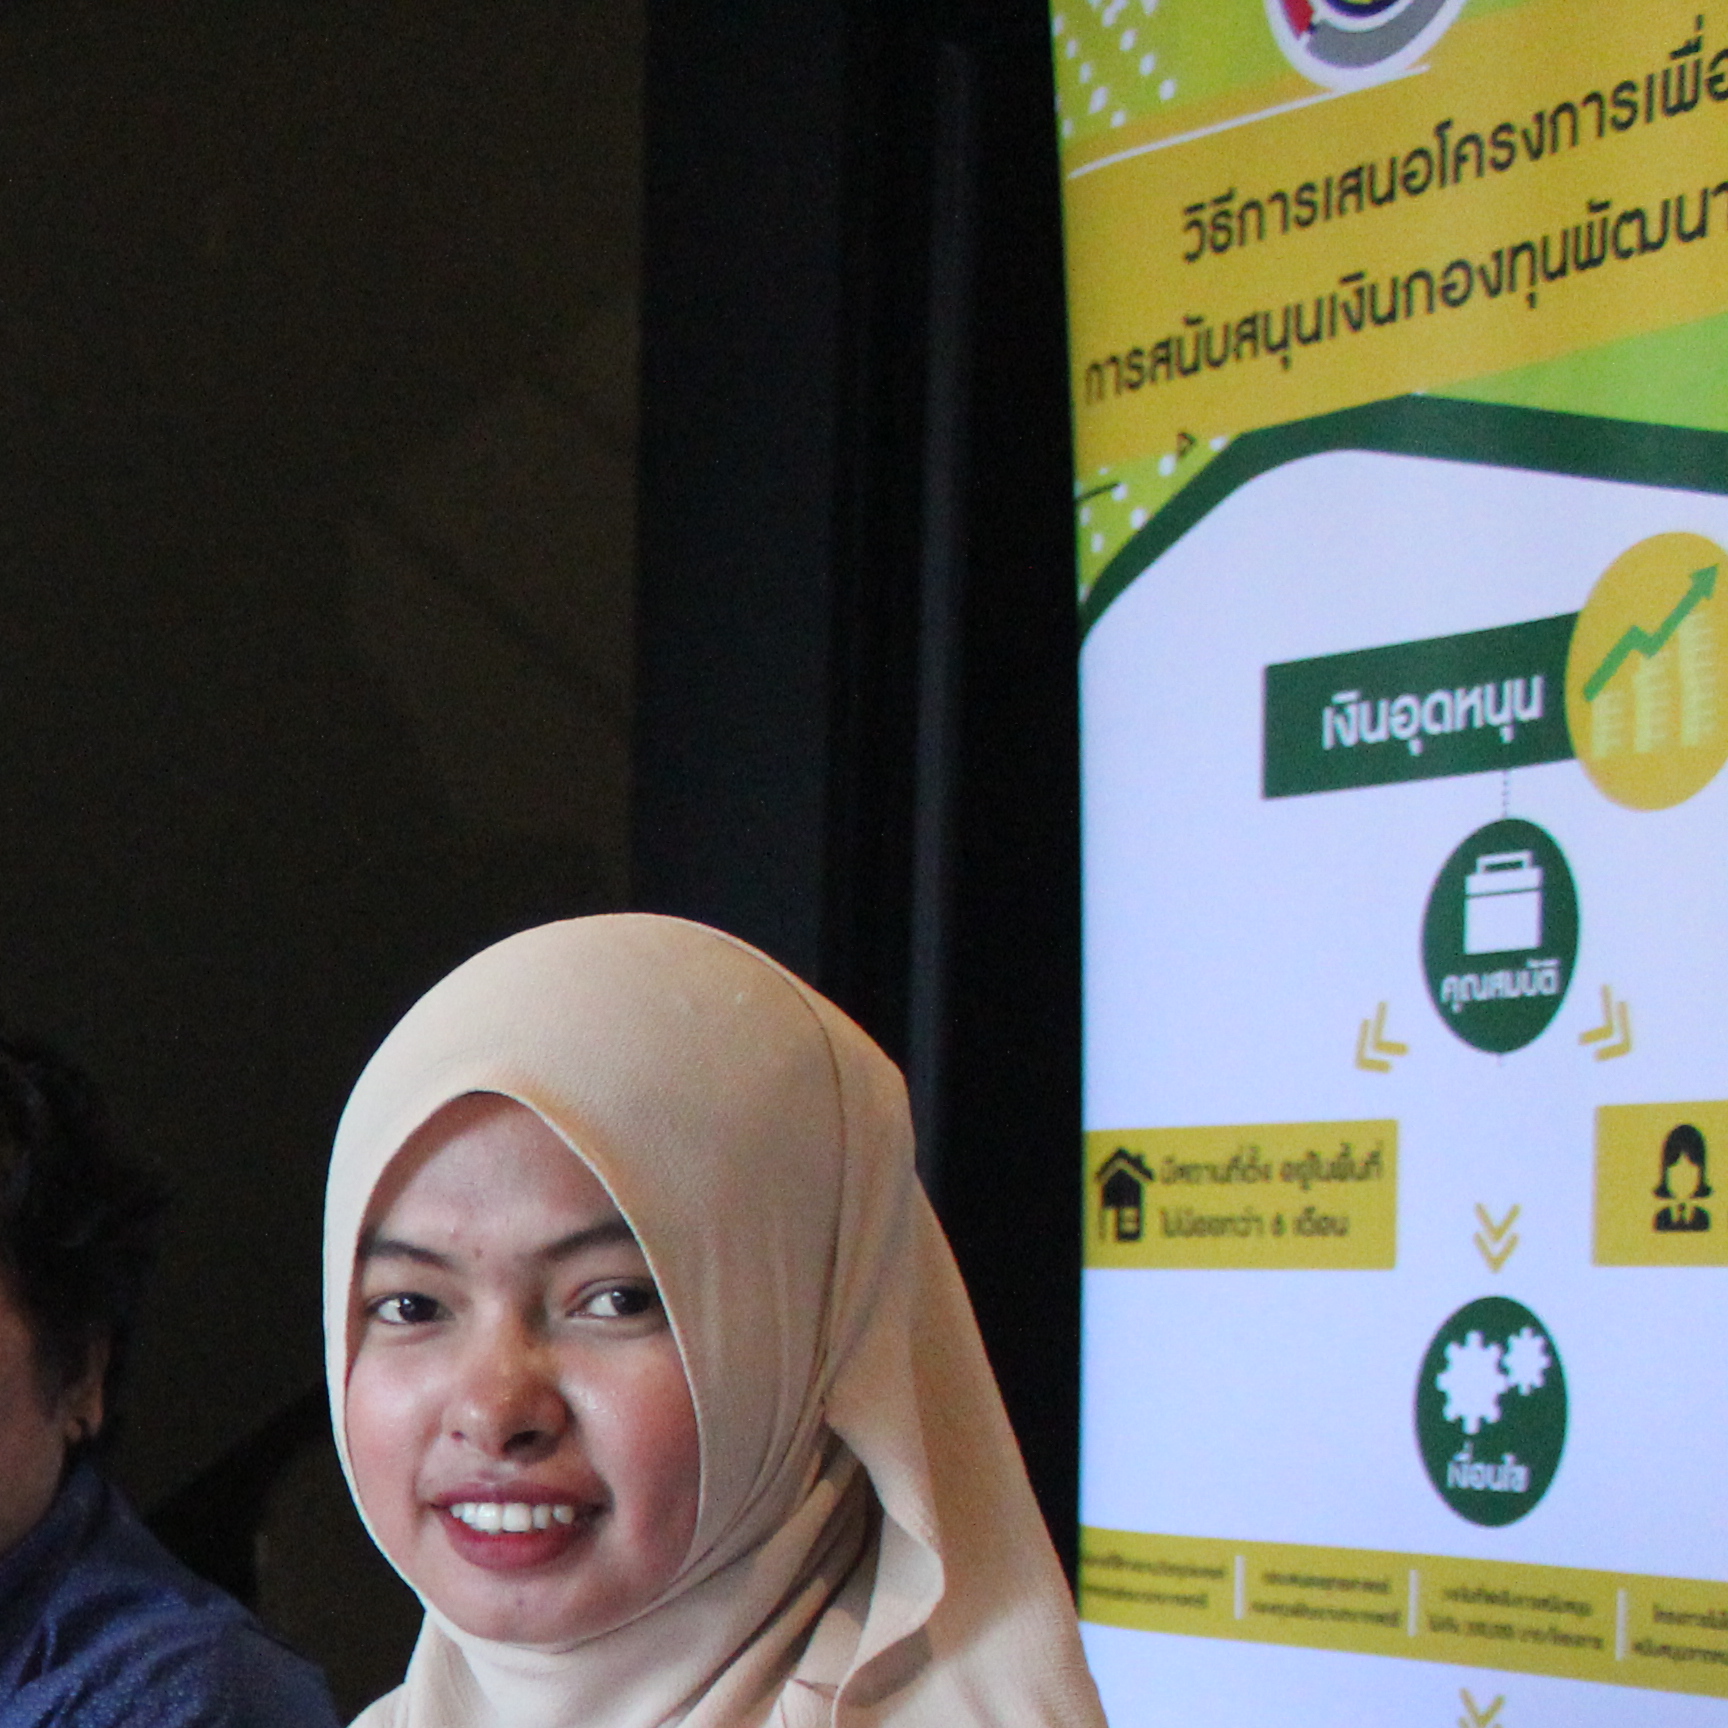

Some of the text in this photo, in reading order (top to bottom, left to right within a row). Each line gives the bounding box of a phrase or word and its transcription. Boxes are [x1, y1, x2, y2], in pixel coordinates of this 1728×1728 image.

[1322, 675, 1544, 757] เงินอุดหนุน
[1441, 957, 1561, 1014] คุณสมบัติ
[1447, 1441, 1529, 1493] เงื่อนไข
